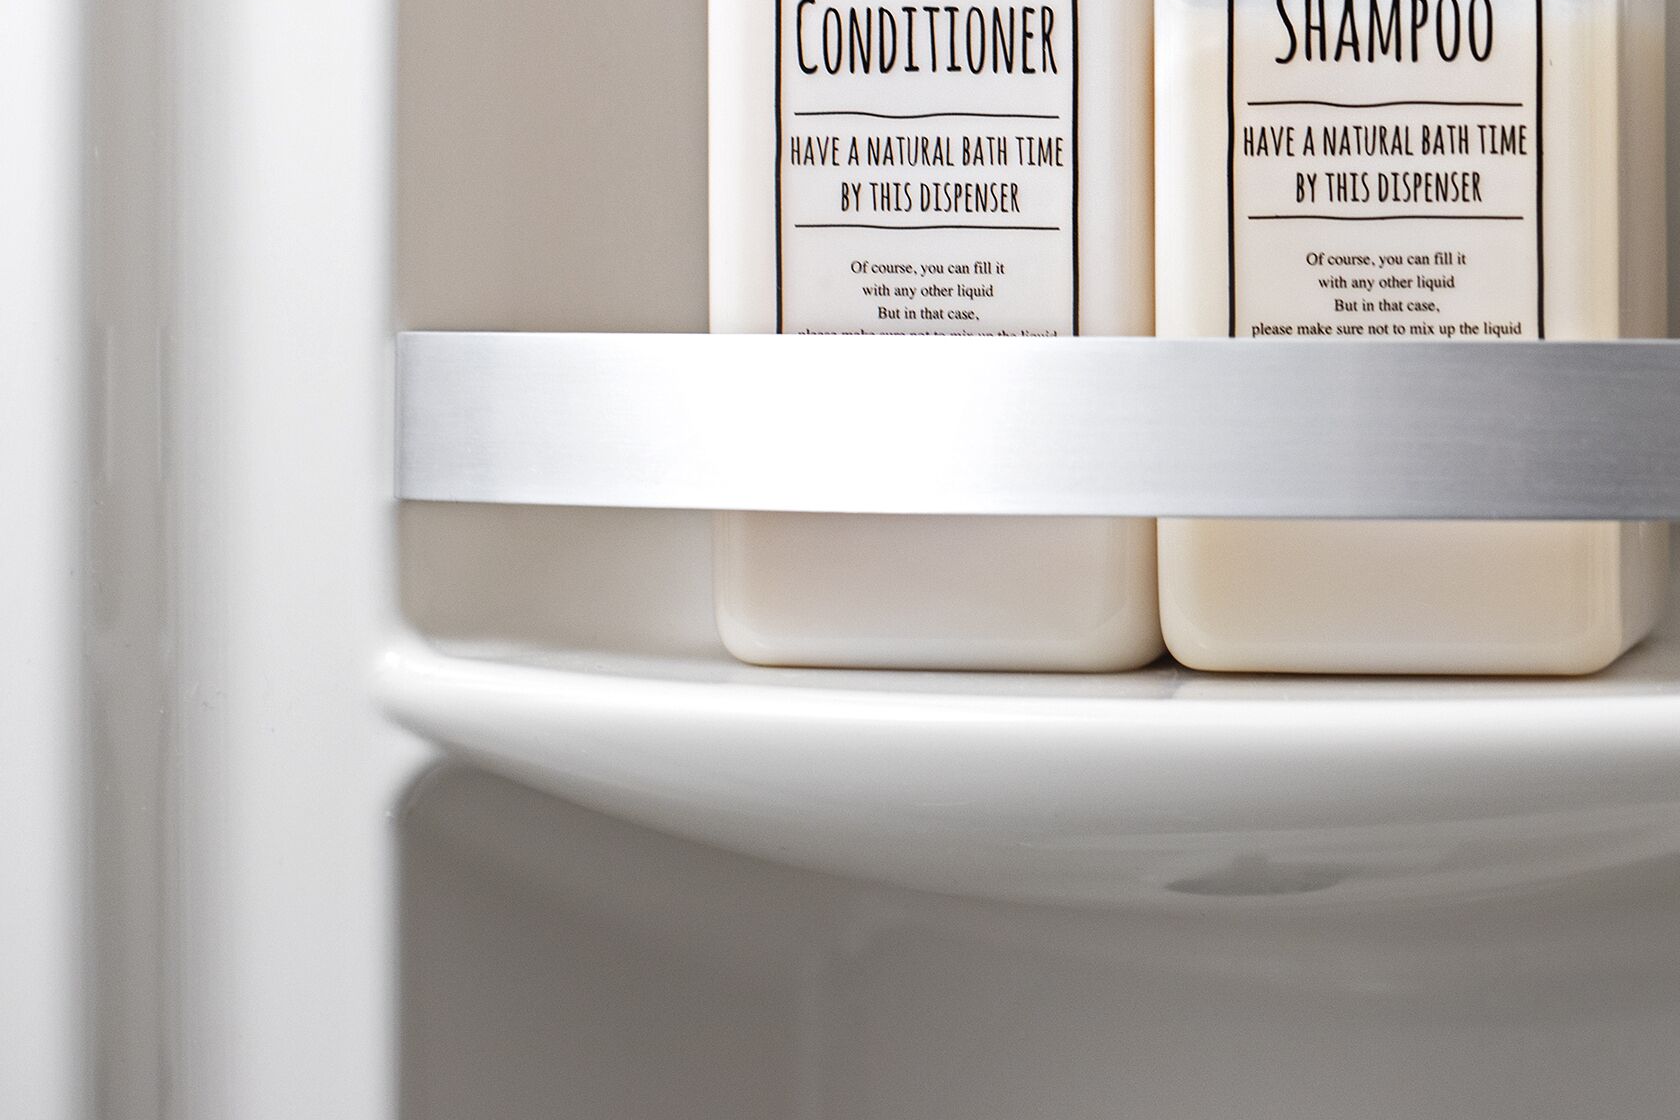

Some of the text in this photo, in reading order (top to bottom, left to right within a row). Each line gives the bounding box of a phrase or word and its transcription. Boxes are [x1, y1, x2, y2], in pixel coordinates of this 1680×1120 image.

[1244, 124, 1527, 157] HAVE A NATURAL BATH TIME
[791, 136, 1064, 167] HAVE A NATURAL BATH TIME
[1296, 171, 1482, 203] BY THIS DISPENSER
[841, 182, 1021, 213] BY THIS DISPENSER
[851, 260, 1005, 277] Of course, you can fill it
[1306, 252, 1467, 269] Of course, you can fill it
[862, 283, 994, 300] with any other liquid
[1318, 275, 1455, 292] with any other liquid
[878, 306, 980, 321] But in that case,
[1334, 298, 1440, 312] But in that case,
[1251, 322, 1522, 338] please make sure not to mix up the liquid
